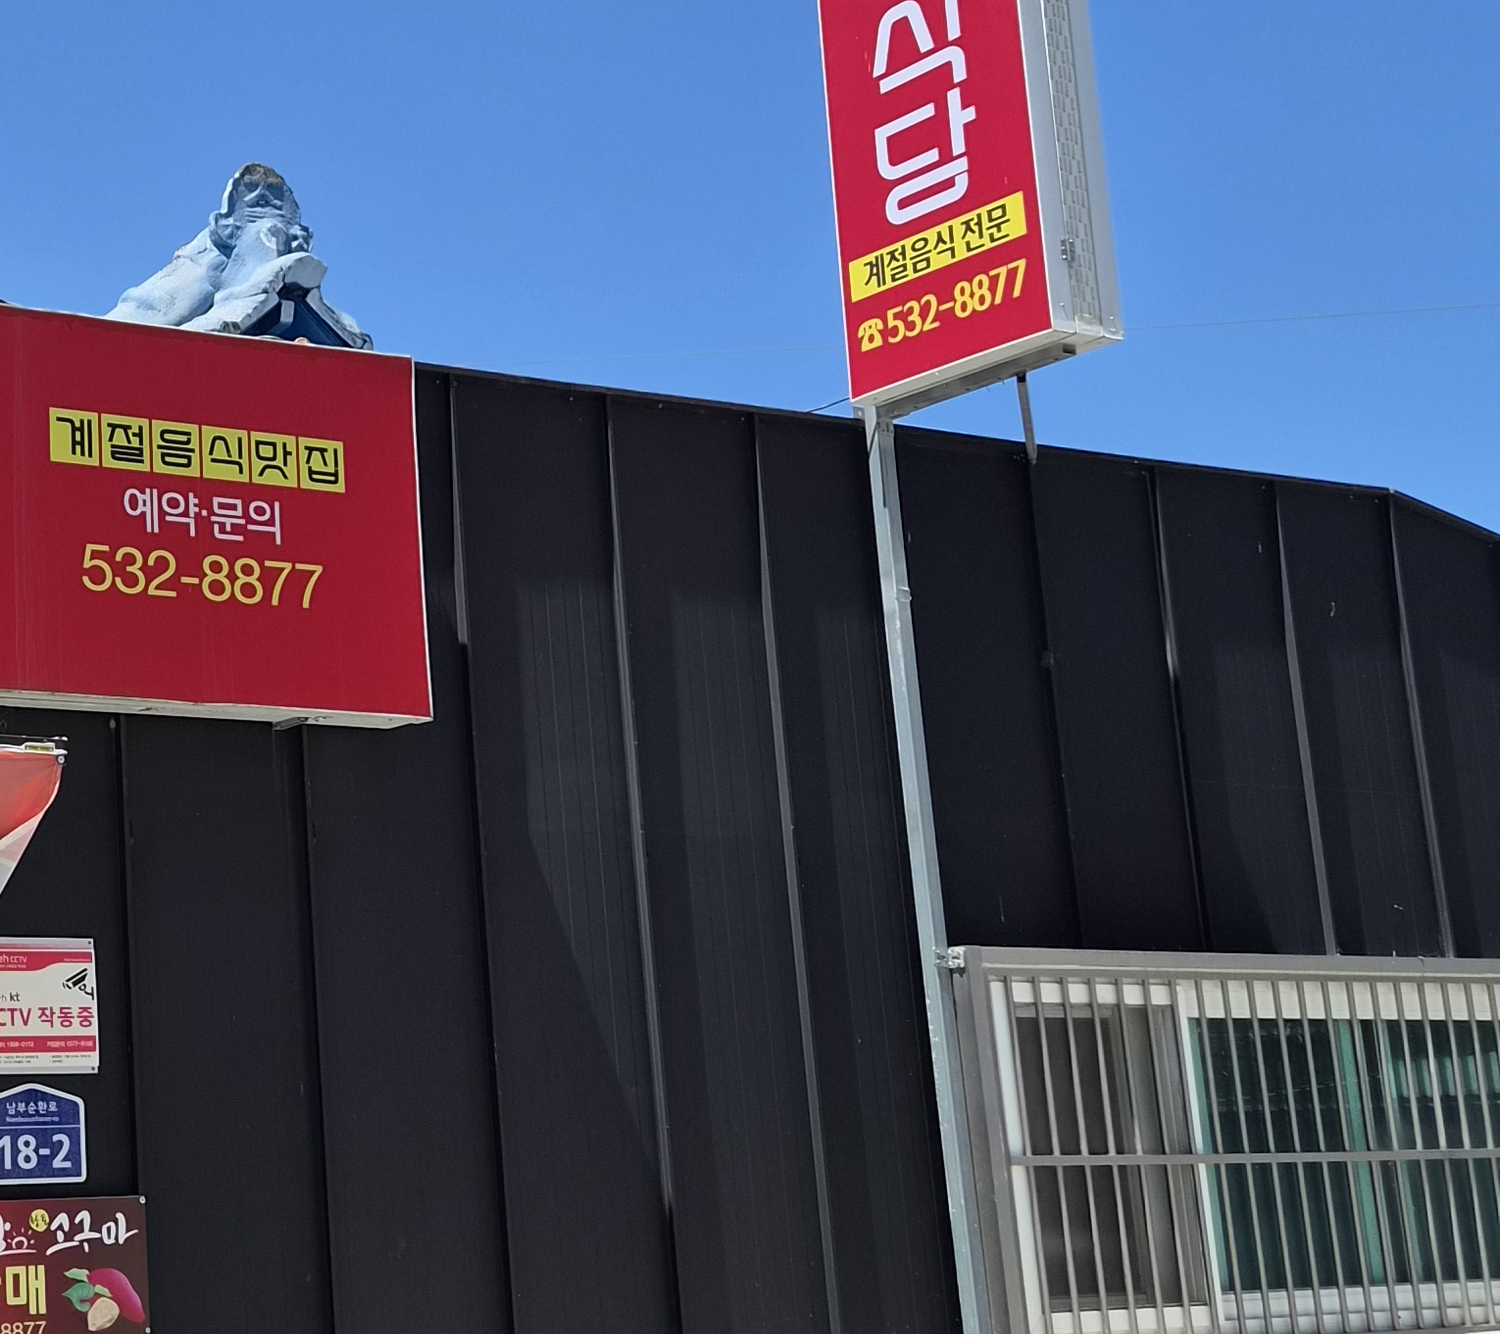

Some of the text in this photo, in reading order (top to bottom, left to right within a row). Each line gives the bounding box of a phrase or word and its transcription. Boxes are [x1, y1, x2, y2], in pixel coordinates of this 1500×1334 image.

[864, 203, 1011, 289] 계절음식 전문
[886, 258, 1027, 344] 532-8877
[55, 413, 342, 486] 계절음식맛집
[81, 544, 324, 610] 532-8877
[9, 992, 20, 1002] kt
[37, 1006, 95, 1028] 작동중
[6, 1100, 58, 1115] 남부순환로
